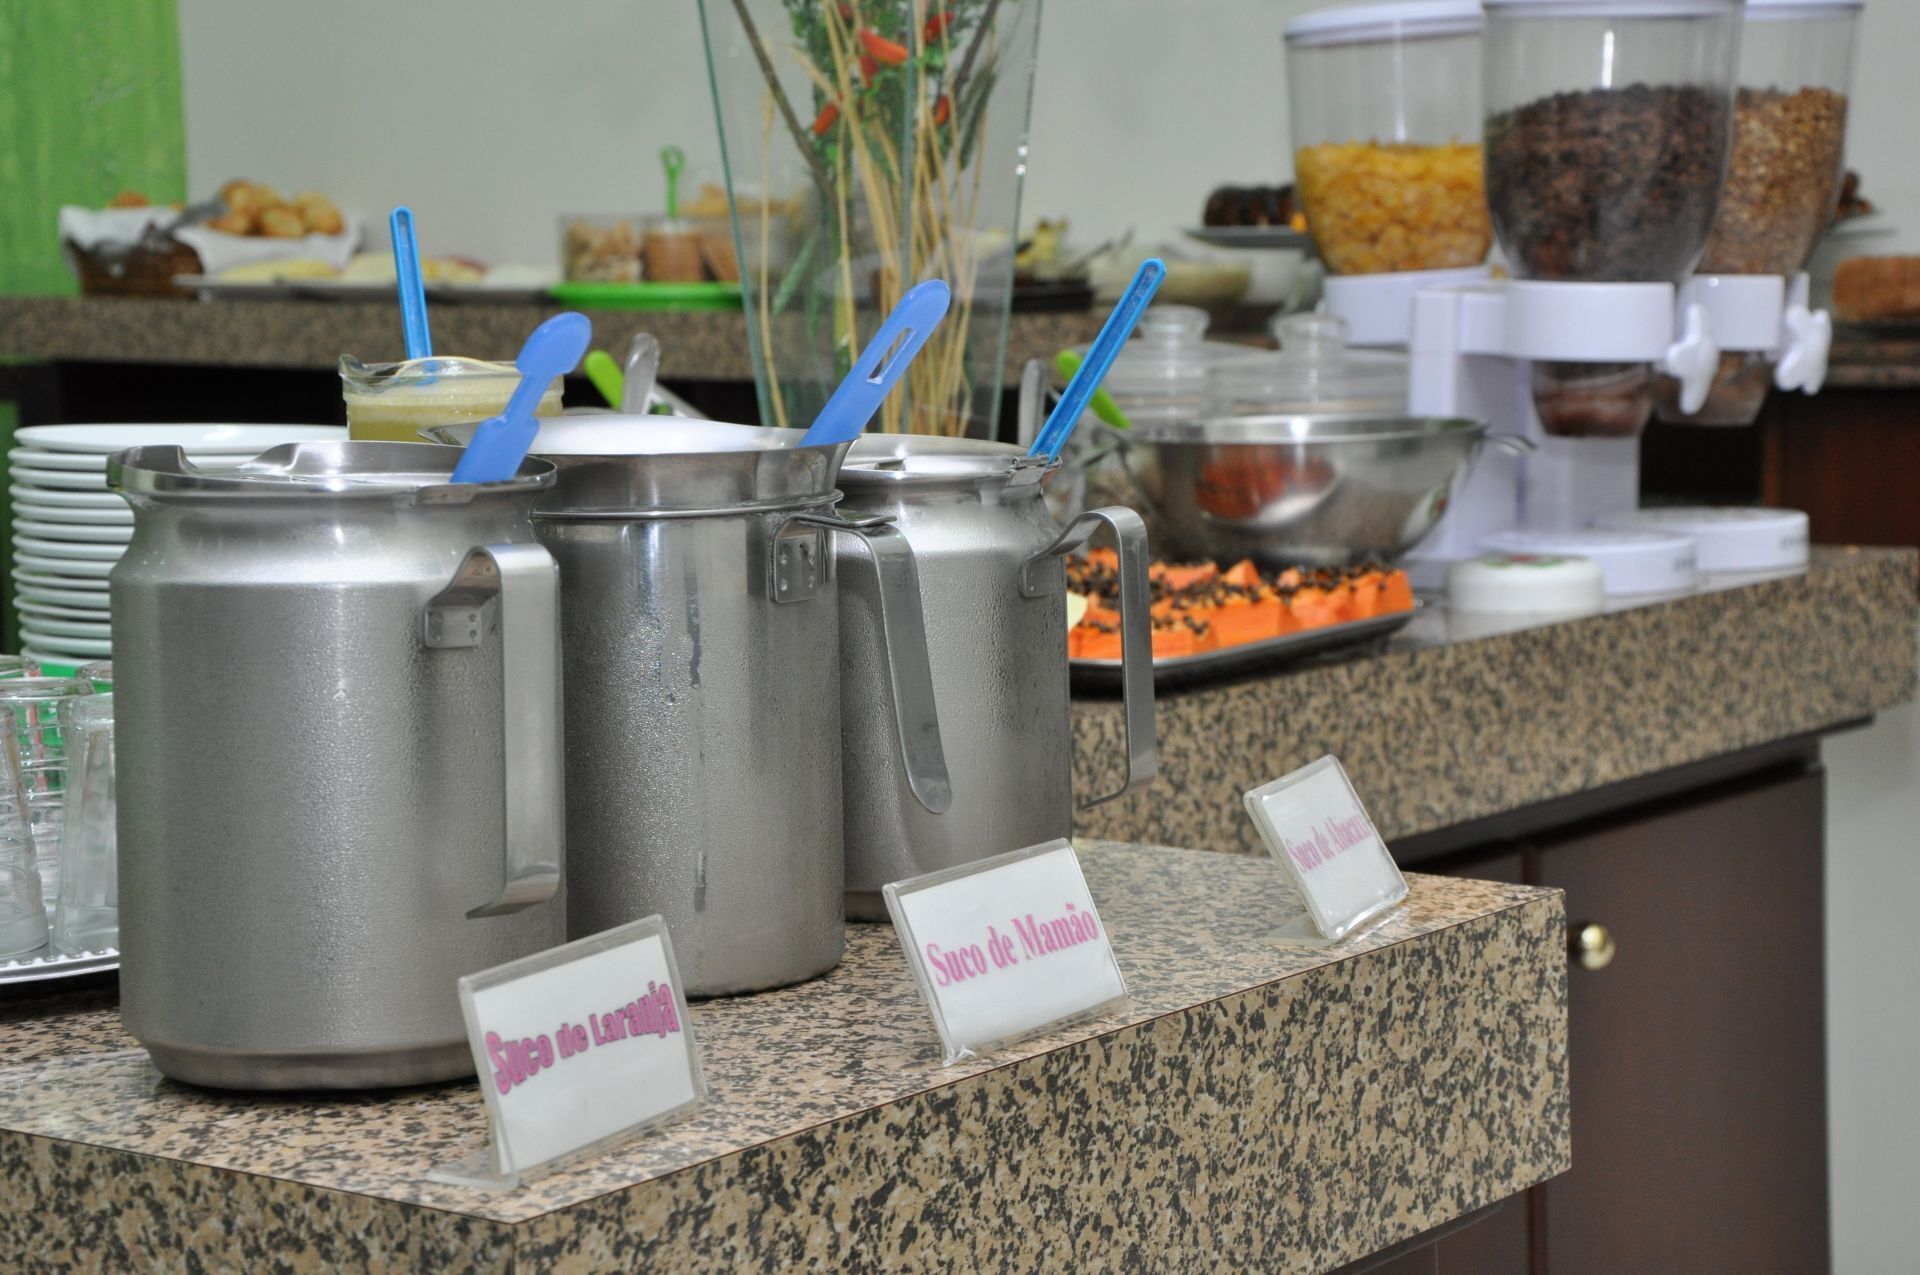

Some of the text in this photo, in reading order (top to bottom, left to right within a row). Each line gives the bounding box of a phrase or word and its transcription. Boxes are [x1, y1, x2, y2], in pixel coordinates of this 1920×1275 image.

[1284, 838, 1322, 874] Suco
[1310, 825, 1335, 860] de
[926, 902, 1099, 987] Suco de Mamão
[485, 980, 681, 1095] Suco de Laranja
